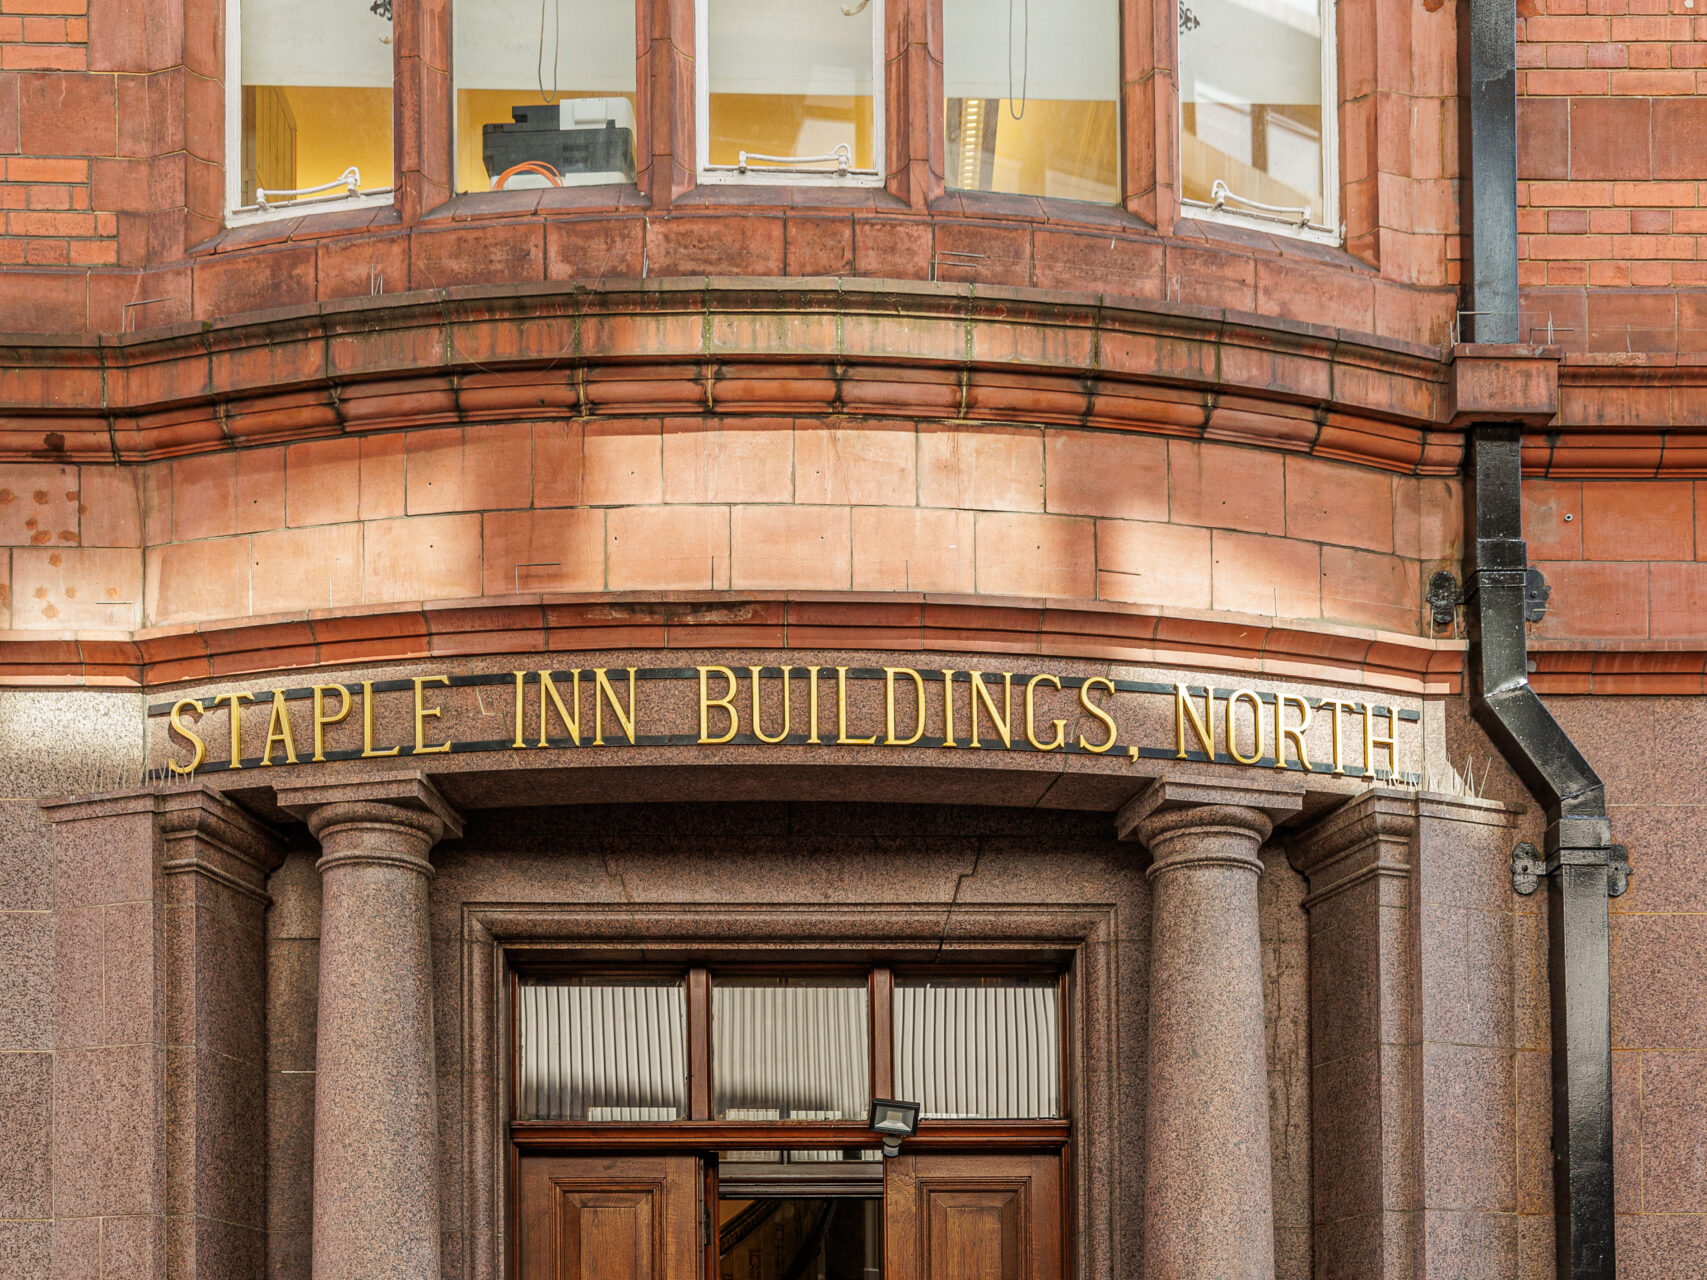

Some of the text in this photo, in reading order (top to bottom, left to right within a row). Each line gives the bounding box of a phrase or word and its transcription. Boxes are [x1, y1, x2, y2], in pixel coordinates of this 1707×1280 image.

[169, 665, 1403, 780] STAPLE INN BUILDINGS, NORTH
